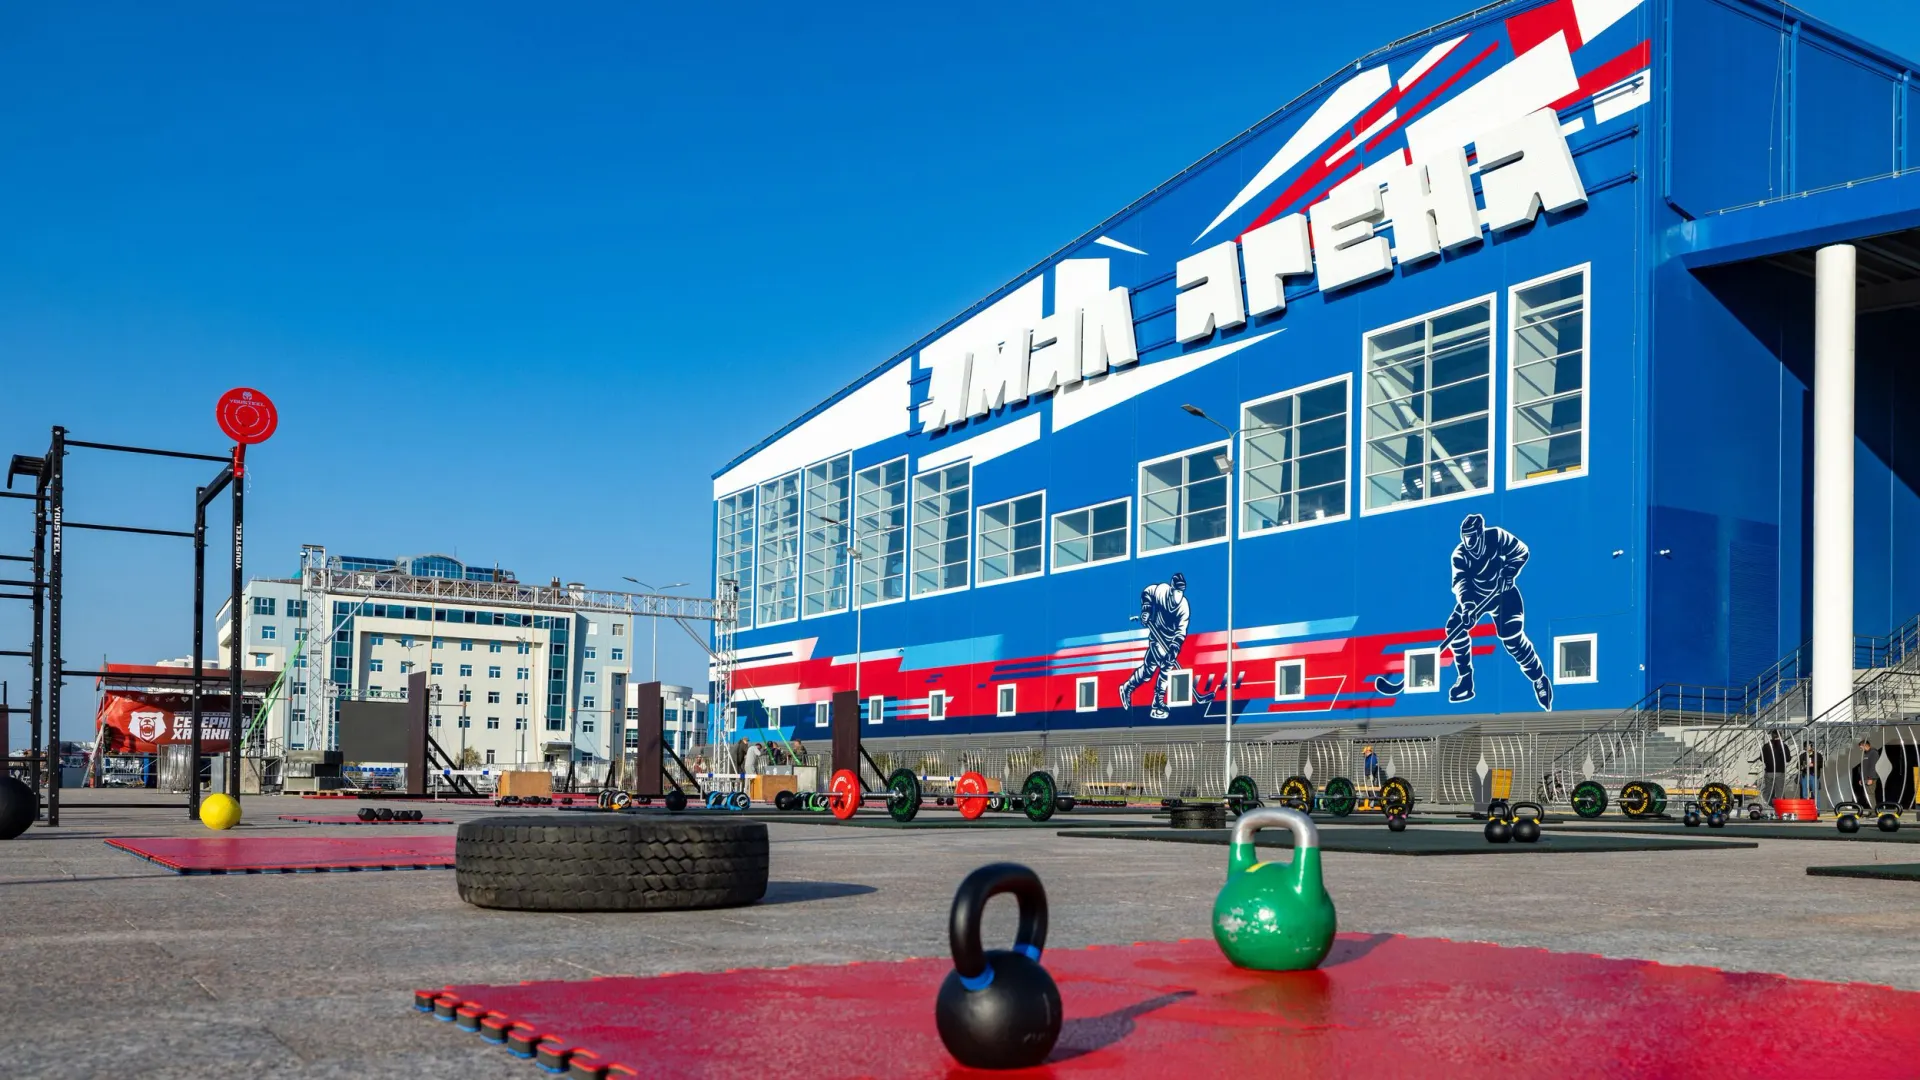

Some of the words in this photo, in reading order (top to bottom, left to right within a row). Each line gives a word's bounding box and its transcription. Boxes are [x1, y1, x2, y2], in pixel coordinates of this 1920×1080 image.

[919, 285, 1138, 434] ЯМАЛ
[1176, 107, 1589, 344] АРЕНА
[229, 399, 265, 407] YOUSTEEL
[53, 506, 61, 556] YOUSTEEL
[173, 715, 251, 728] СЕЕРНЙ
[171, 728, 250, 740] ХААКТР
